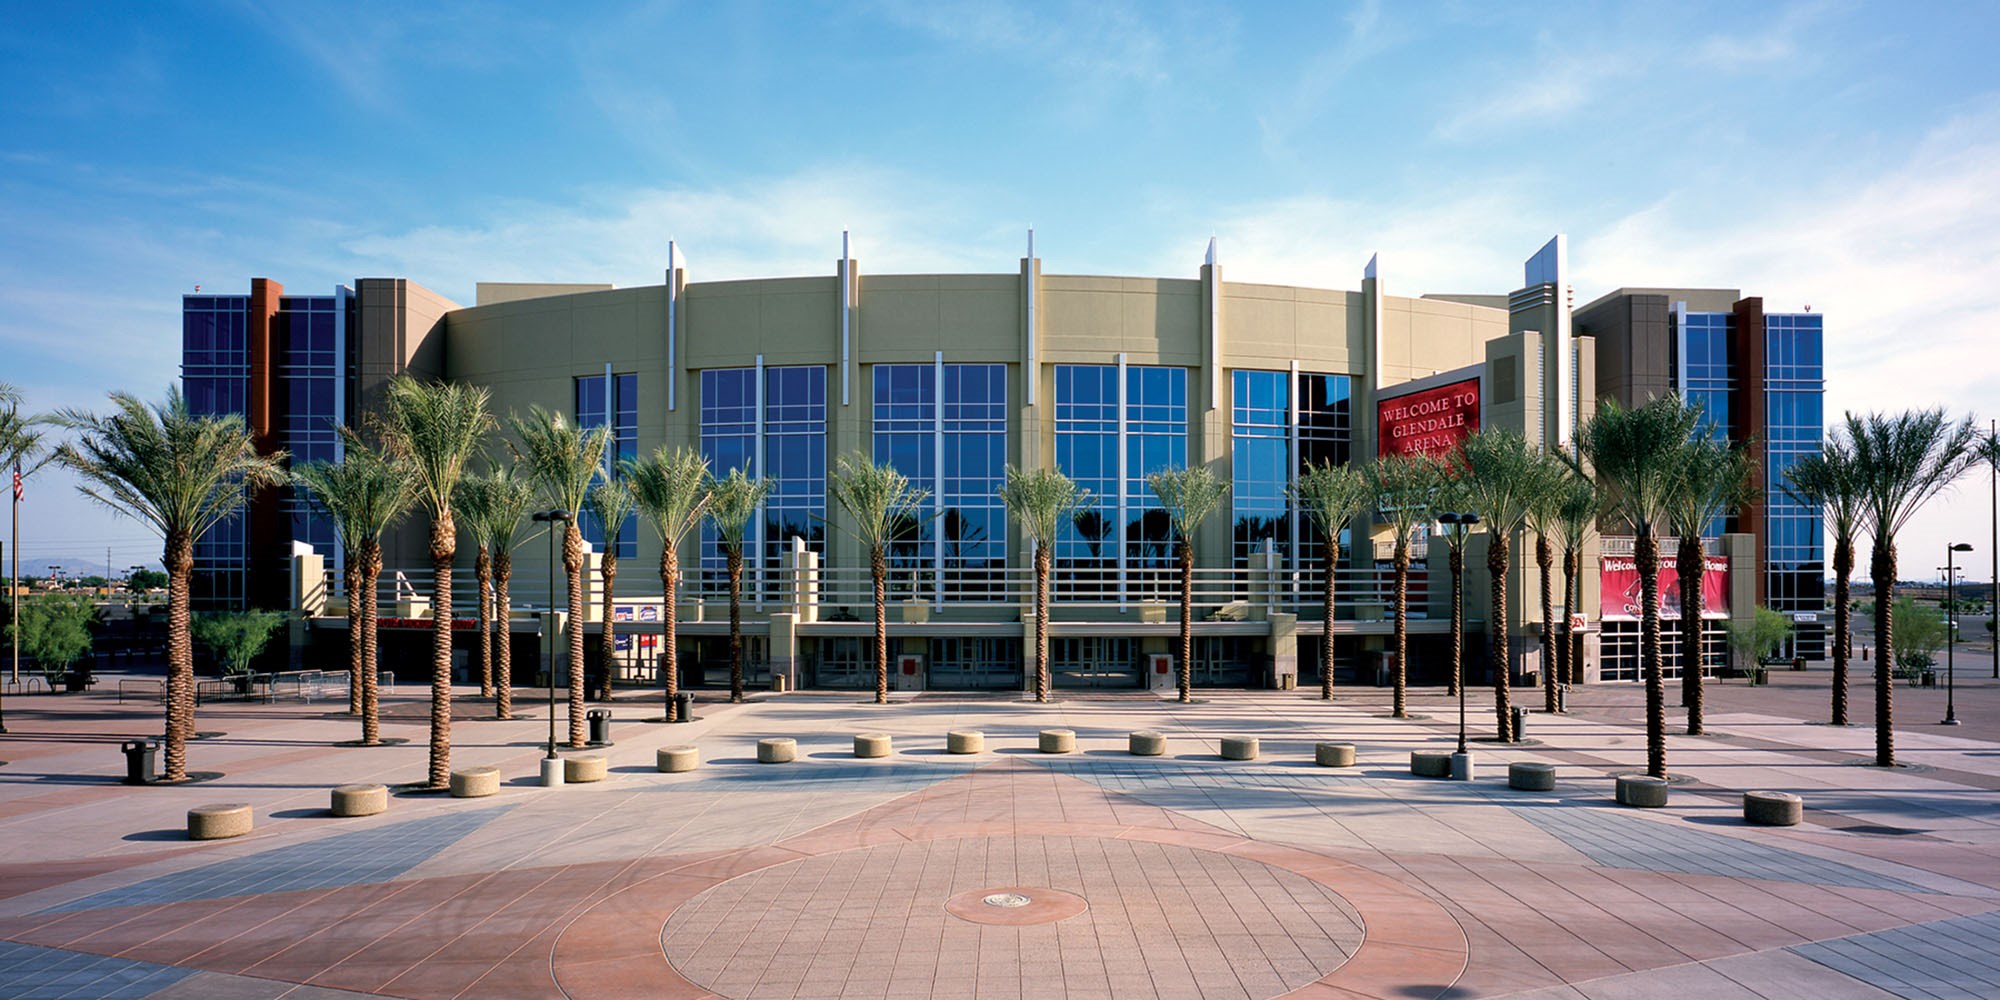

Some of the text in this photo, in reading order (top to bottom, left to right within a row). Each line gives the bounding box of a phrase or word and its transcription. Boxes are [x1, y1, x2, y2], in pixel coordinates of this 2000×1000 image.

[1384, 392, 1475, 421] WELCOME TO
[1393, 413, 1465, 438] GLENDALE
[1404, 434, 1452, 453] ARENA
[1605, 560, 1637, 572] Welco
[1705, 561, 1728, 572] Home
